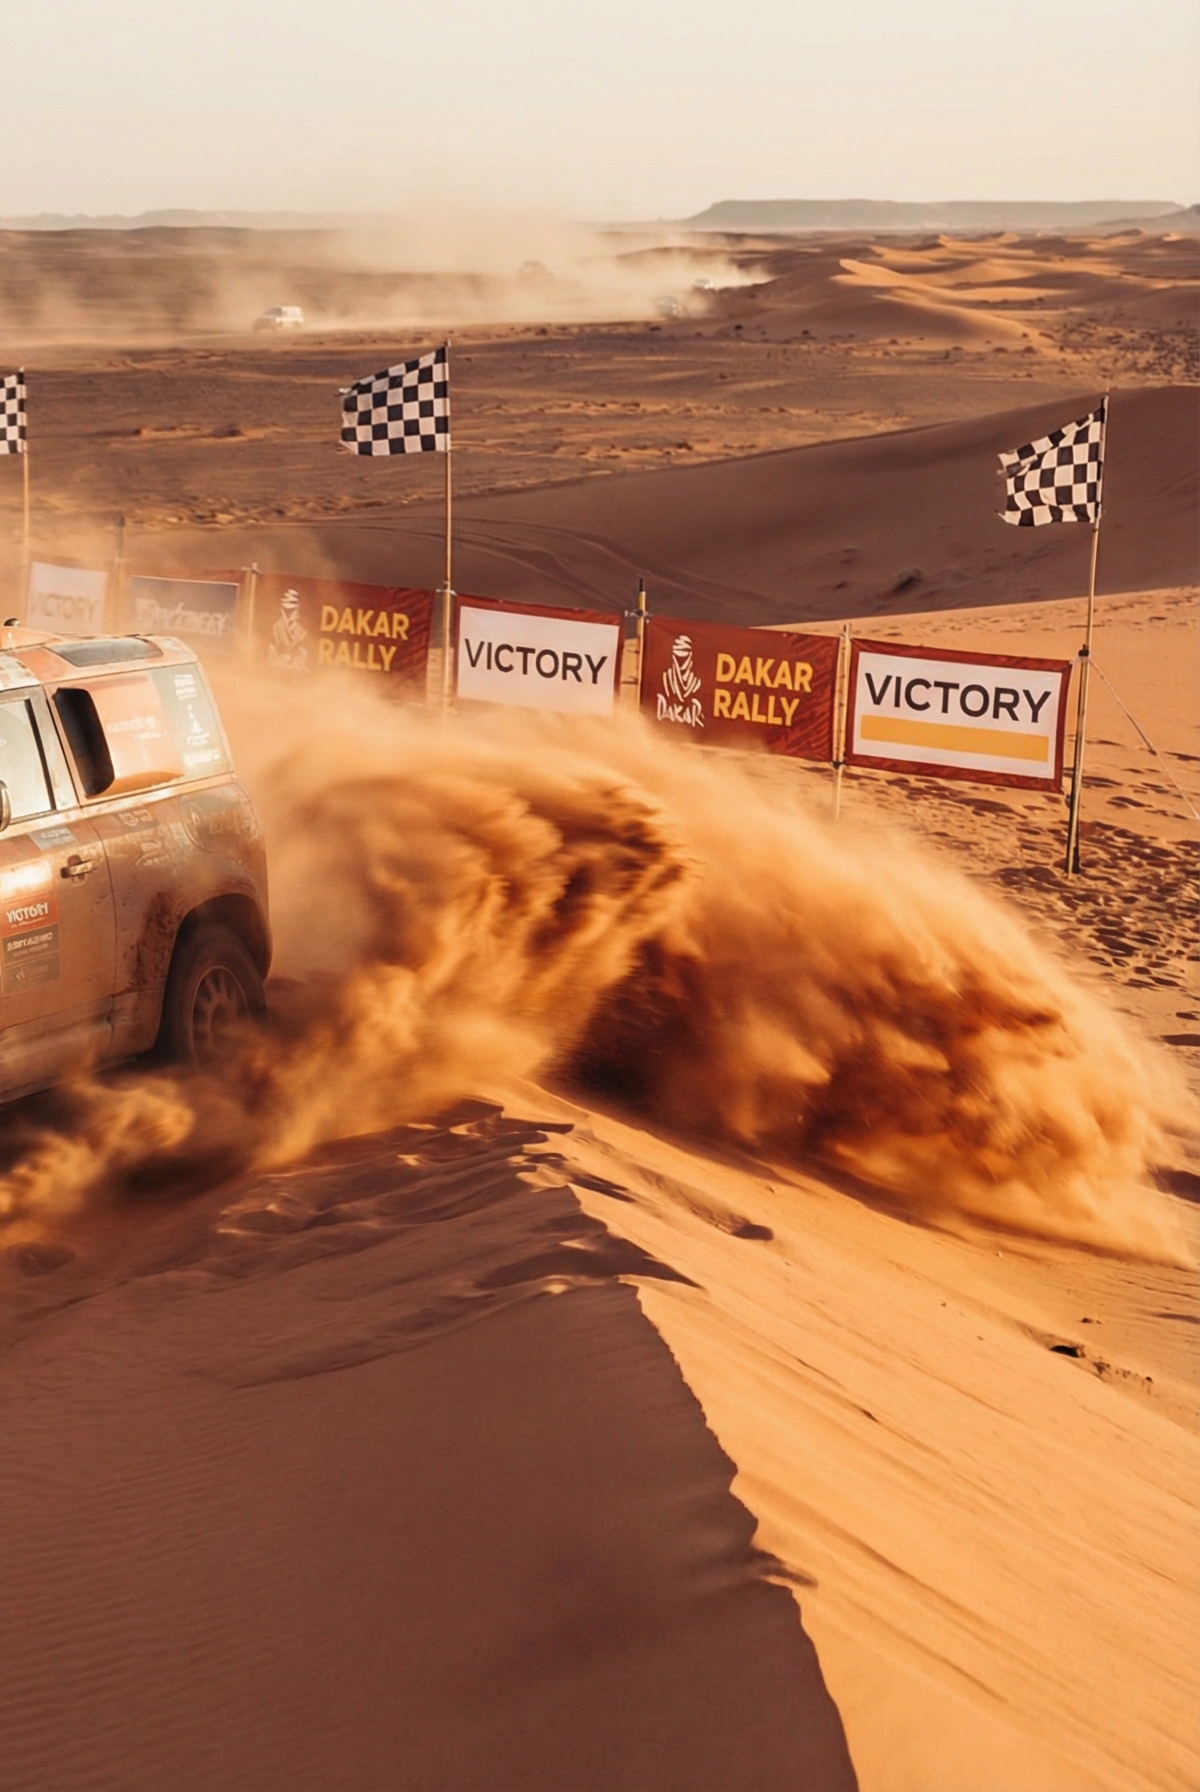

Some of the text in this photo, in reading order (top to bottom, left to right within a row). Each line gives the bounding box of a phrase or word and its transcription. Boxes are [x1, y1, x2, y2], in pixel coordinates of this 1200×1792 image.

[320, 604, 410, 641] DAKAR
[318, 638, 398, 672] RALLY
[464, 638, 608, 685] VICTORY
[716, 653, 813, 693] DAKAR
[656, 693, 705, 728] DAKAR
[713, 688, 800, 727] RALLY
[865, 672, 1052, 723] VICTORY
